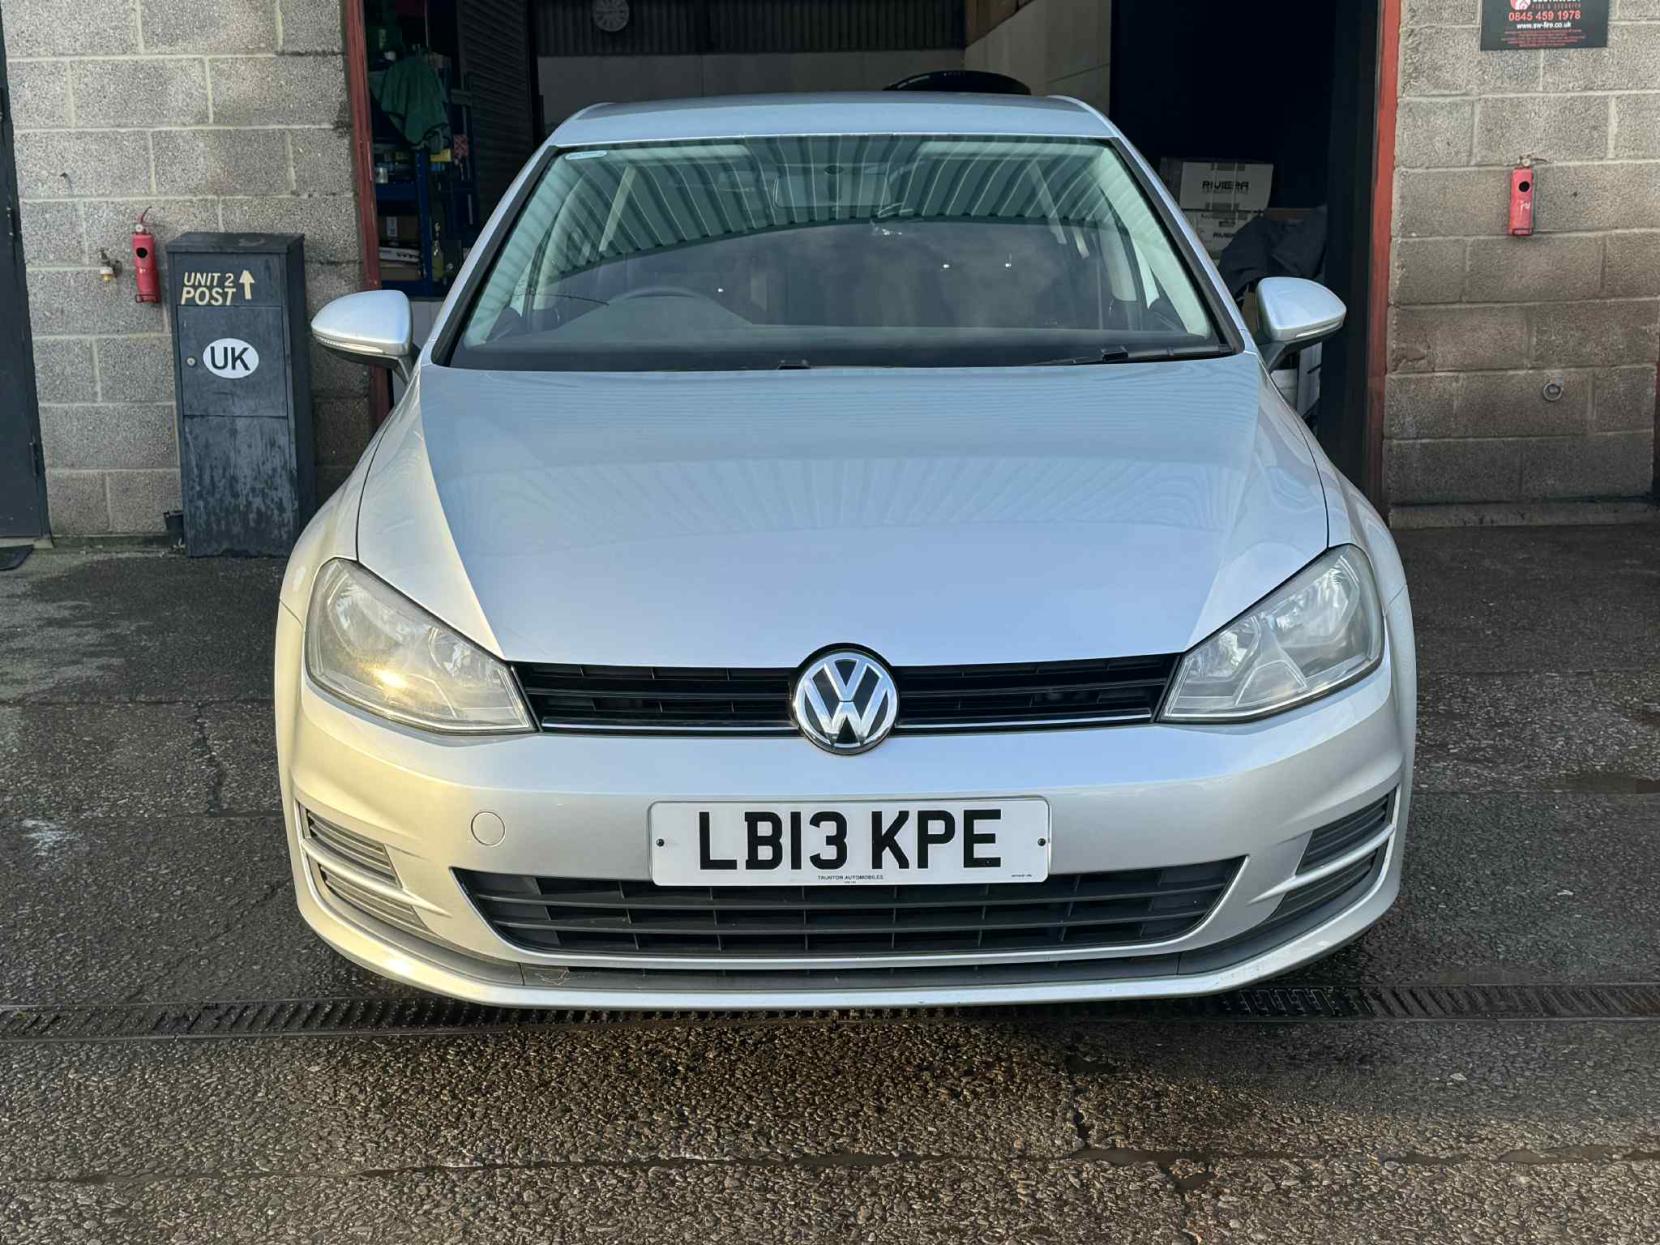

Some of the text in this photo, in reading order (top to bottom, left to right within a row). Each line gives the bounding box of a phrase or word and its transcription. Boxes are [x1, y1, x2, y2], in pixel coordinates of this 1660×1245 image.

[1508, 10, 1581, 22] 0845 459 1978
[183, 271, 235, 287] UNIT 2
[181, 287, 236, 306] POST
[210, 346, 251, 371] UK
[796, 651, 898, 749] VW
[699, 808, 1001, 871] LB13 KPE
